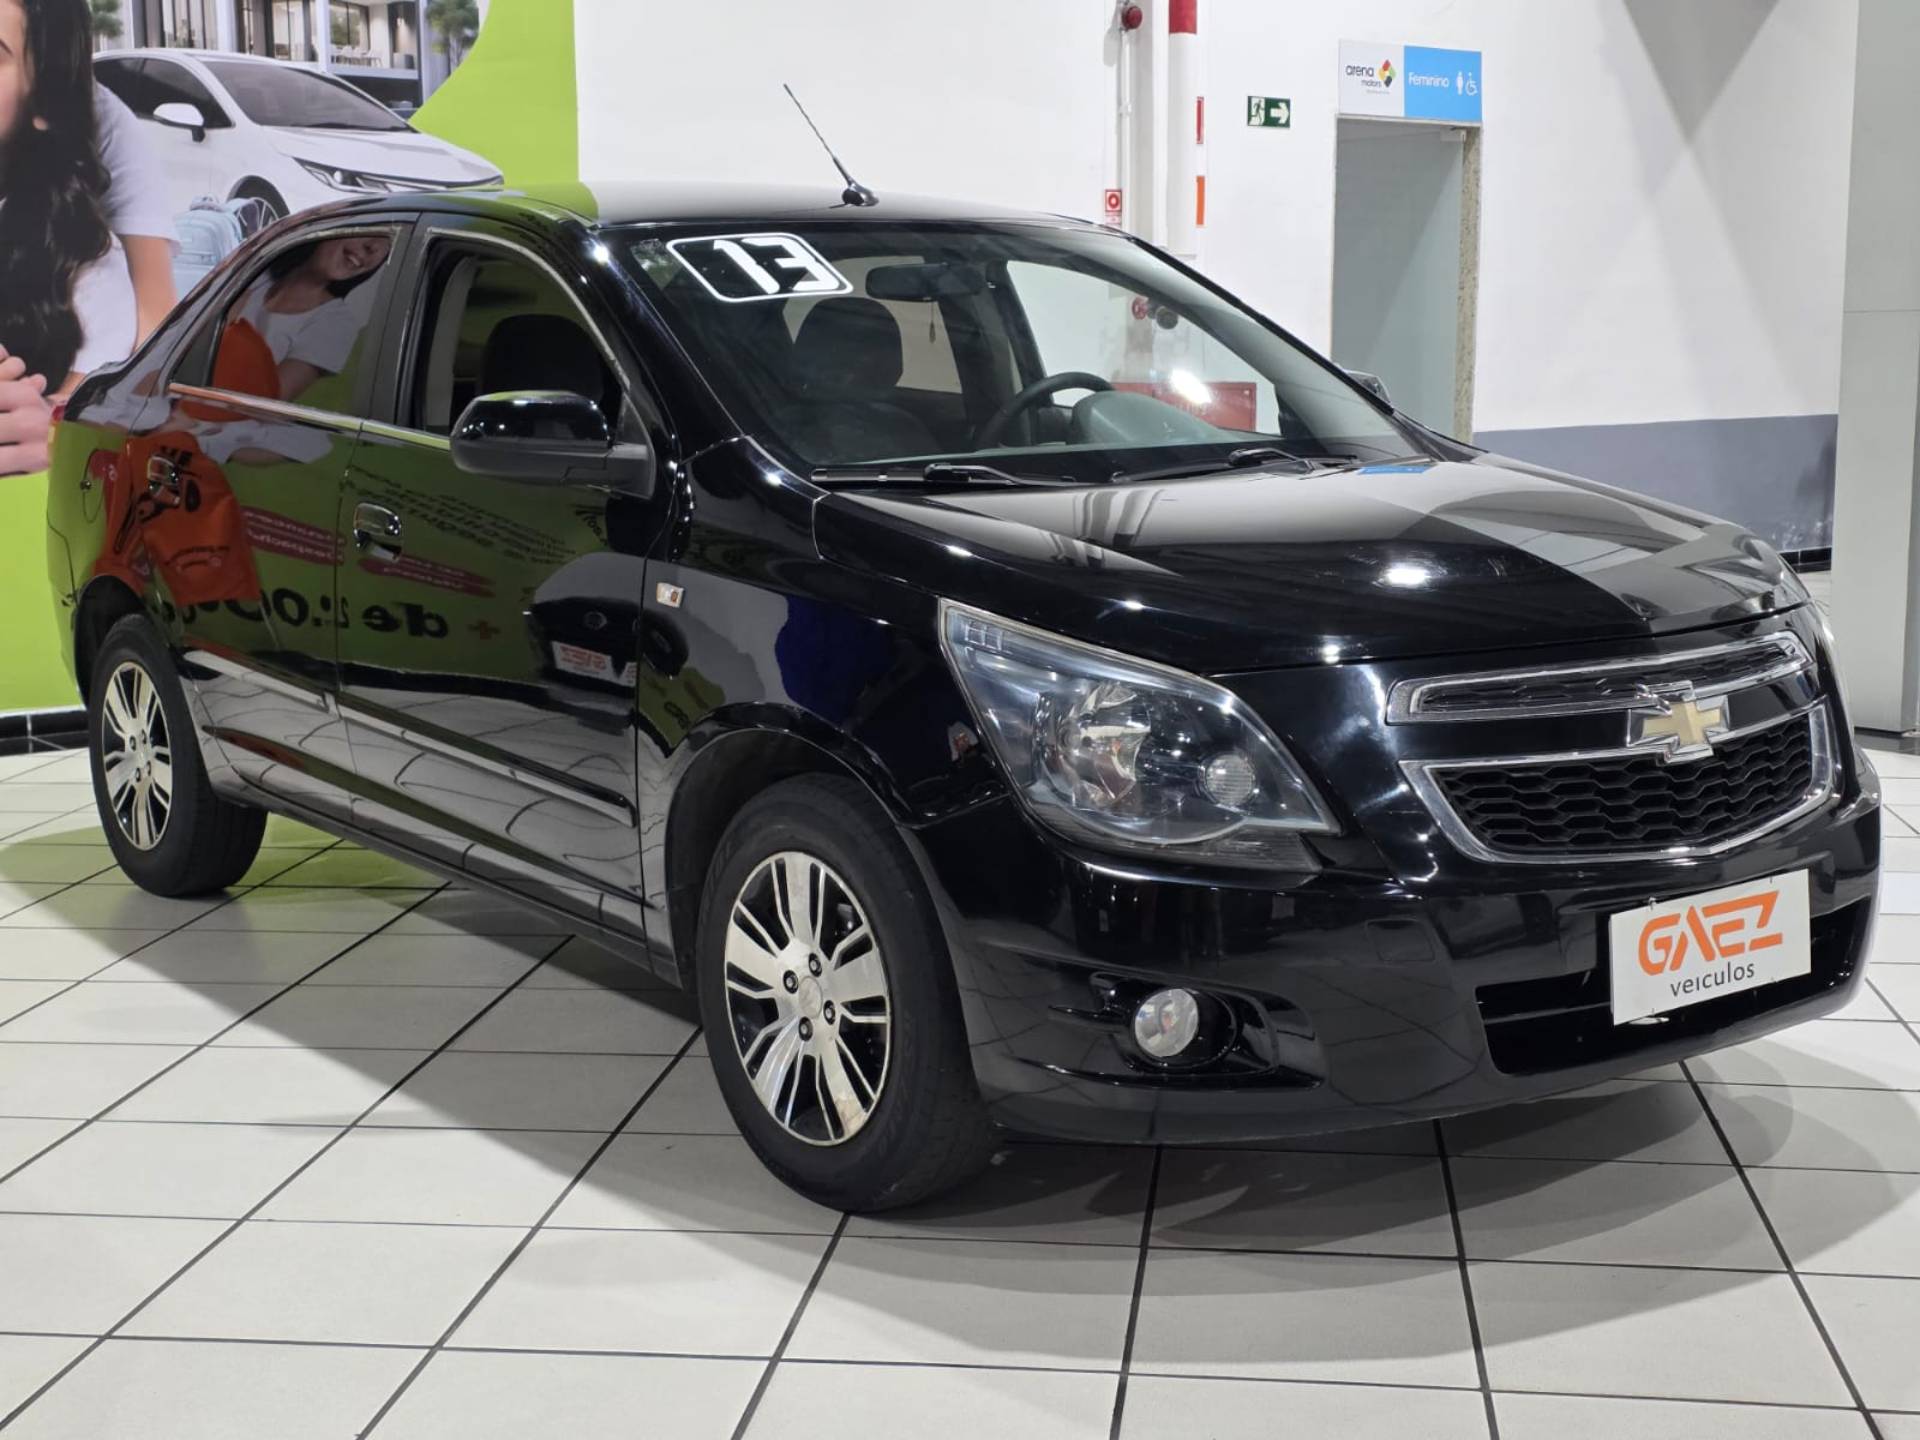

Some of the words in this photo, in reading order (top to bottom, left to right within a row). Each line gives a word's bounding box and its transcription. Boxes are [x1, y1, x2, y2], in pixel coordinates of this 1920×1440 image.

[1345, 65, 1375, 77] arena
[1408, 72, 1449, 88] Feminino
[712, 236, 840, 295] 13
[1638, 890, 1783, 976] GAEZ
[1670, 961, 1755, 997] veiculos
